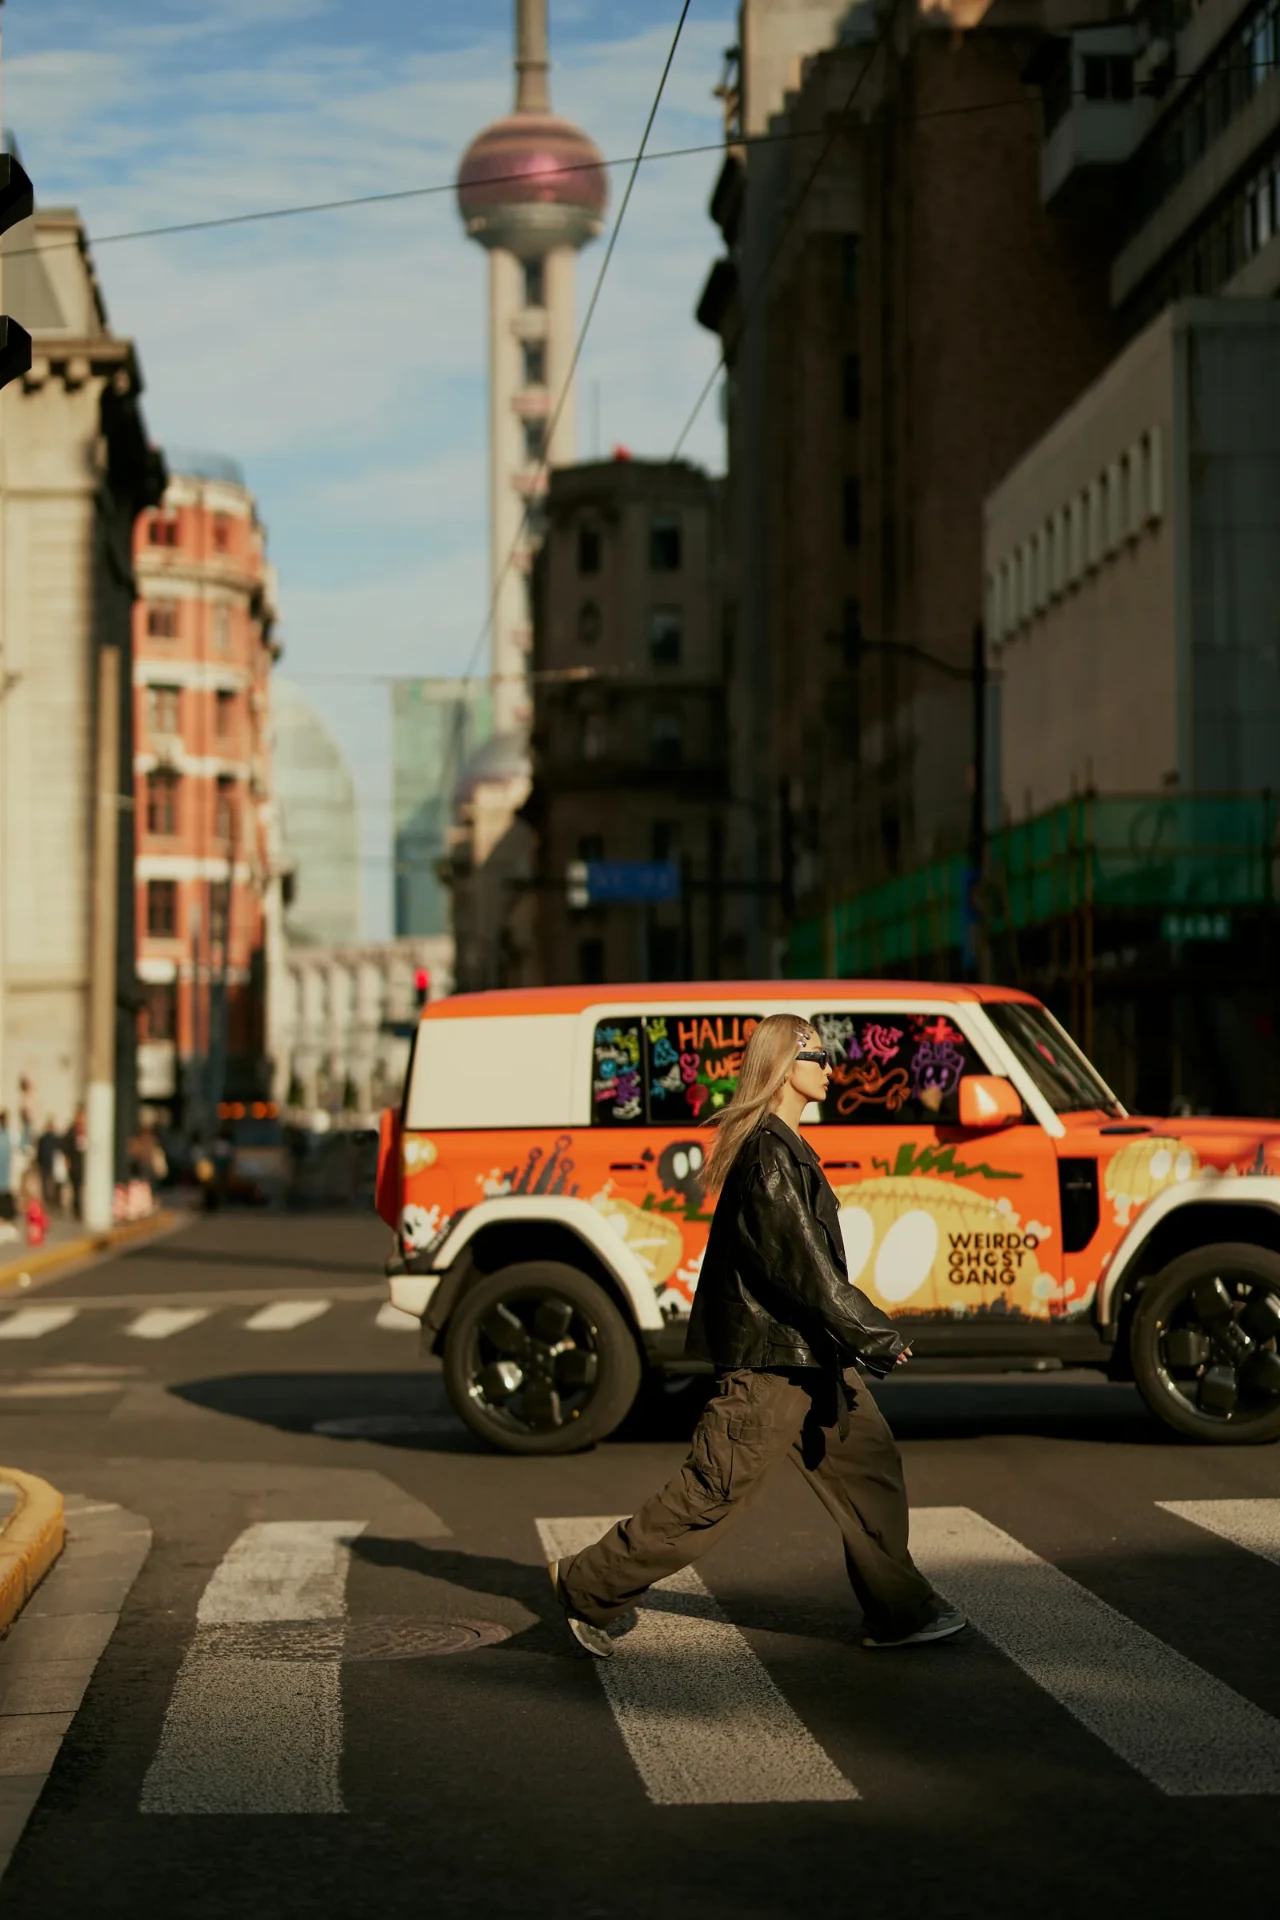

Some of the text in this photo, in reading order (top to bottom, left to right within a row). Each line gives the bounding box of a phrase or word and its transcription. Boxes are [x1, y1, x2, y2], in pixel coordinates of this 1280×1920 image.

[948, 1233, 1039, 1250] WEIRDO
[948, 1250, 1026, 1268] GHOST
[948, 1268, 1016, 1285] GANG
